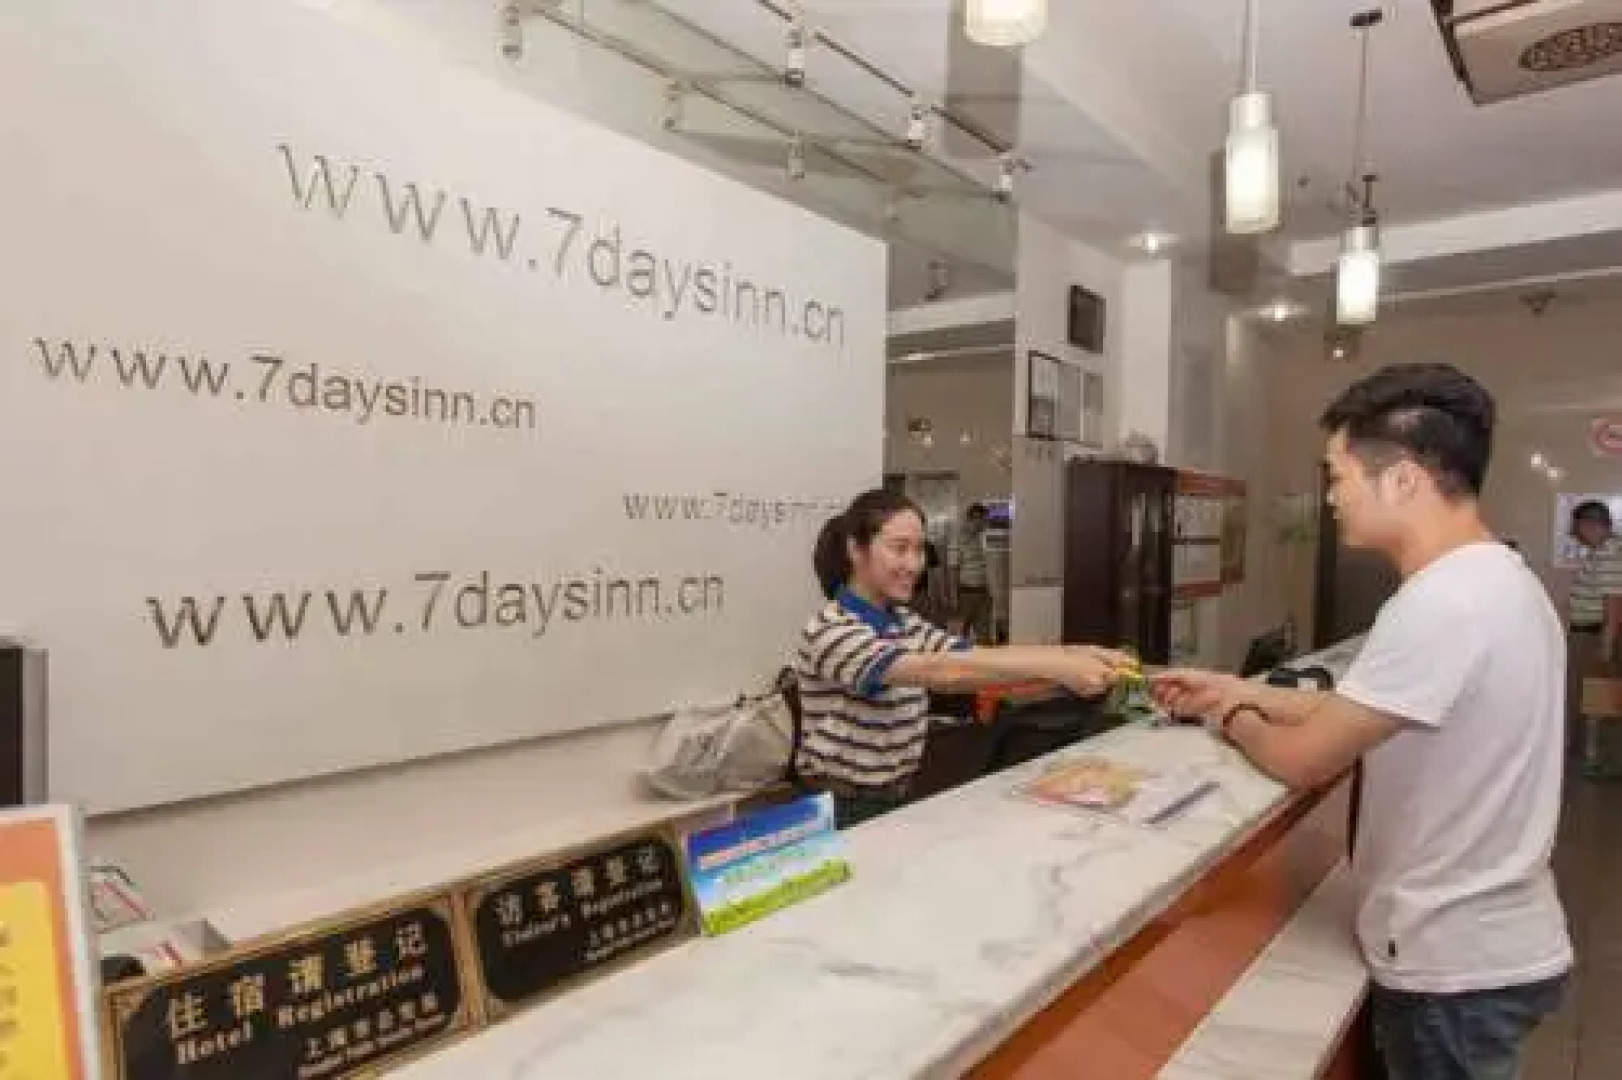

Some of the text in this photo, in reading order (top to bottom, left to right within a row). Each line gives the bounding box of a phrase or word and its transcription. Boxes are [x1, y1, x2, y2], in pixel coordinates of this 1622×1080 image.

[277, 141, 846, 346] www.7daysinn.cn
[35, 336, 537, 429] www.7daysinn.cn
[145, 567, 725, 648] www.7daysinn.cn
